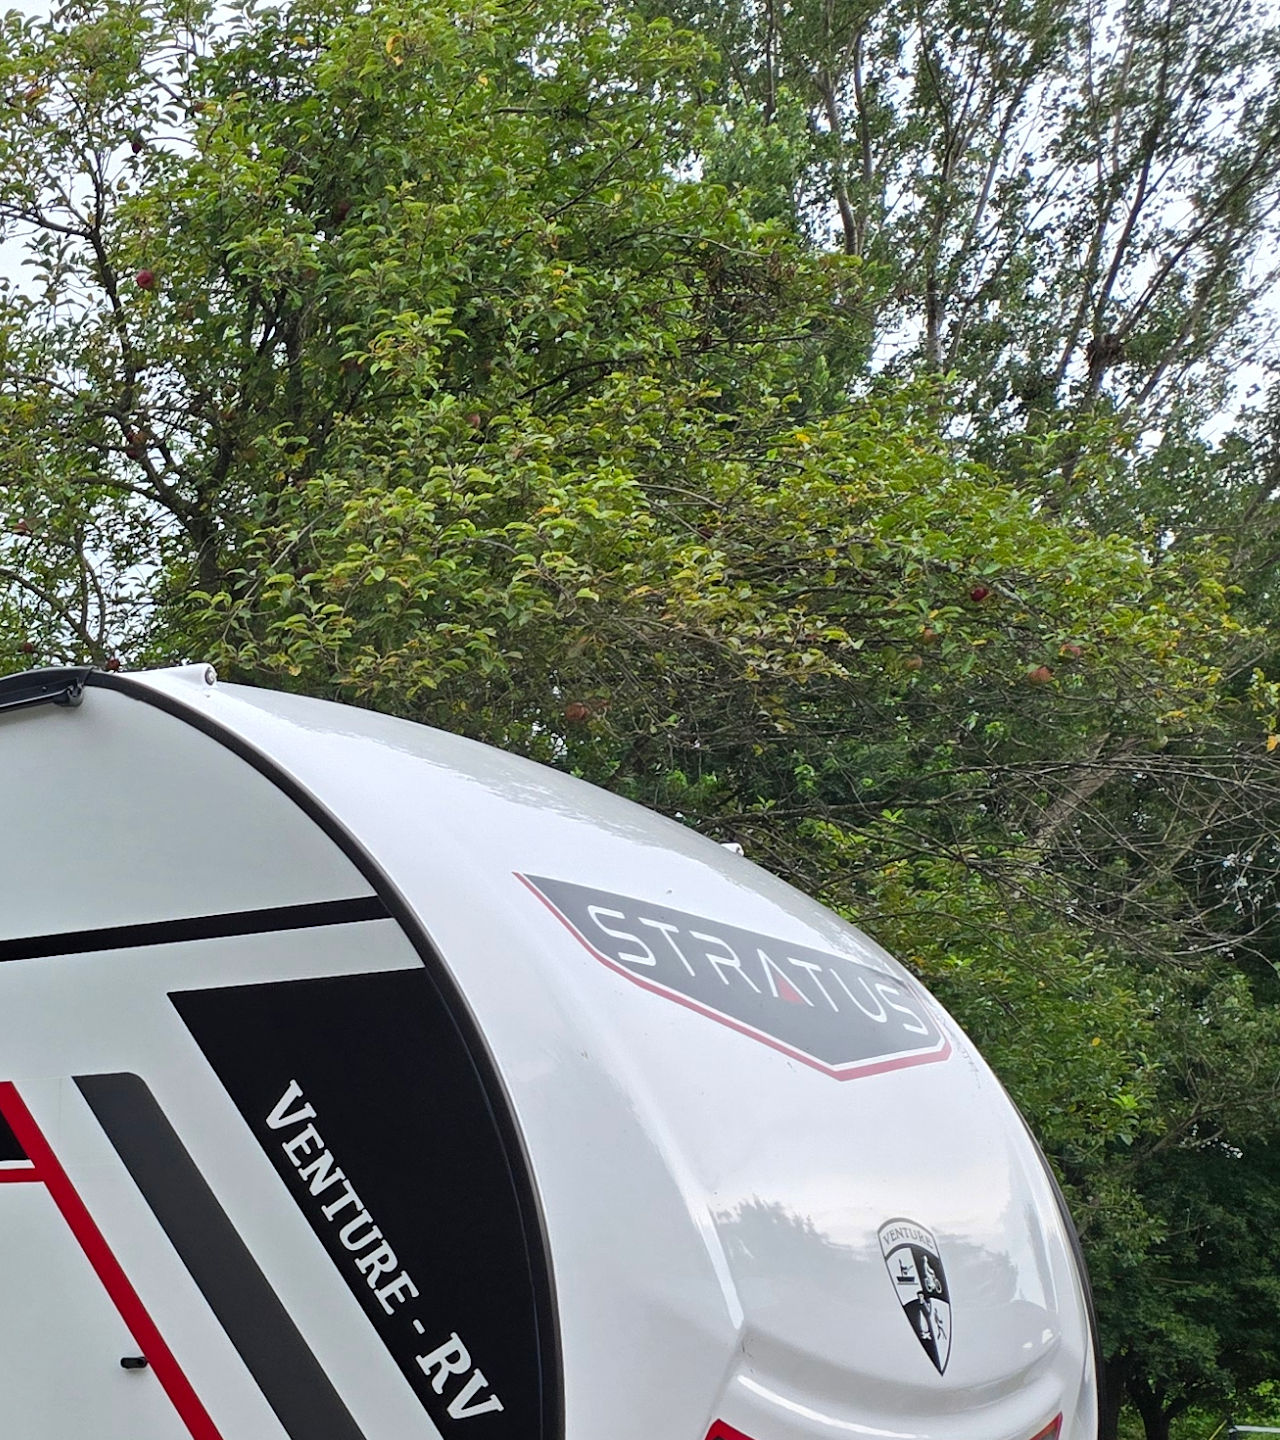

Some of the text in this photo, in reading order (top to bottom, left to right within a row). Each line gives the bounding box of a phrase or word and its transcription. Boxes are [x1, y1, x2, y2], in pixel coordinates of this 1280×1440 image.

[587, 905, 928, 1035] STRATUS
[265, 1079, 419, 1315] VENTURE
[415, 1332, 504, 1420] RV
[883, 1227, 934, 1250] VENTURE
